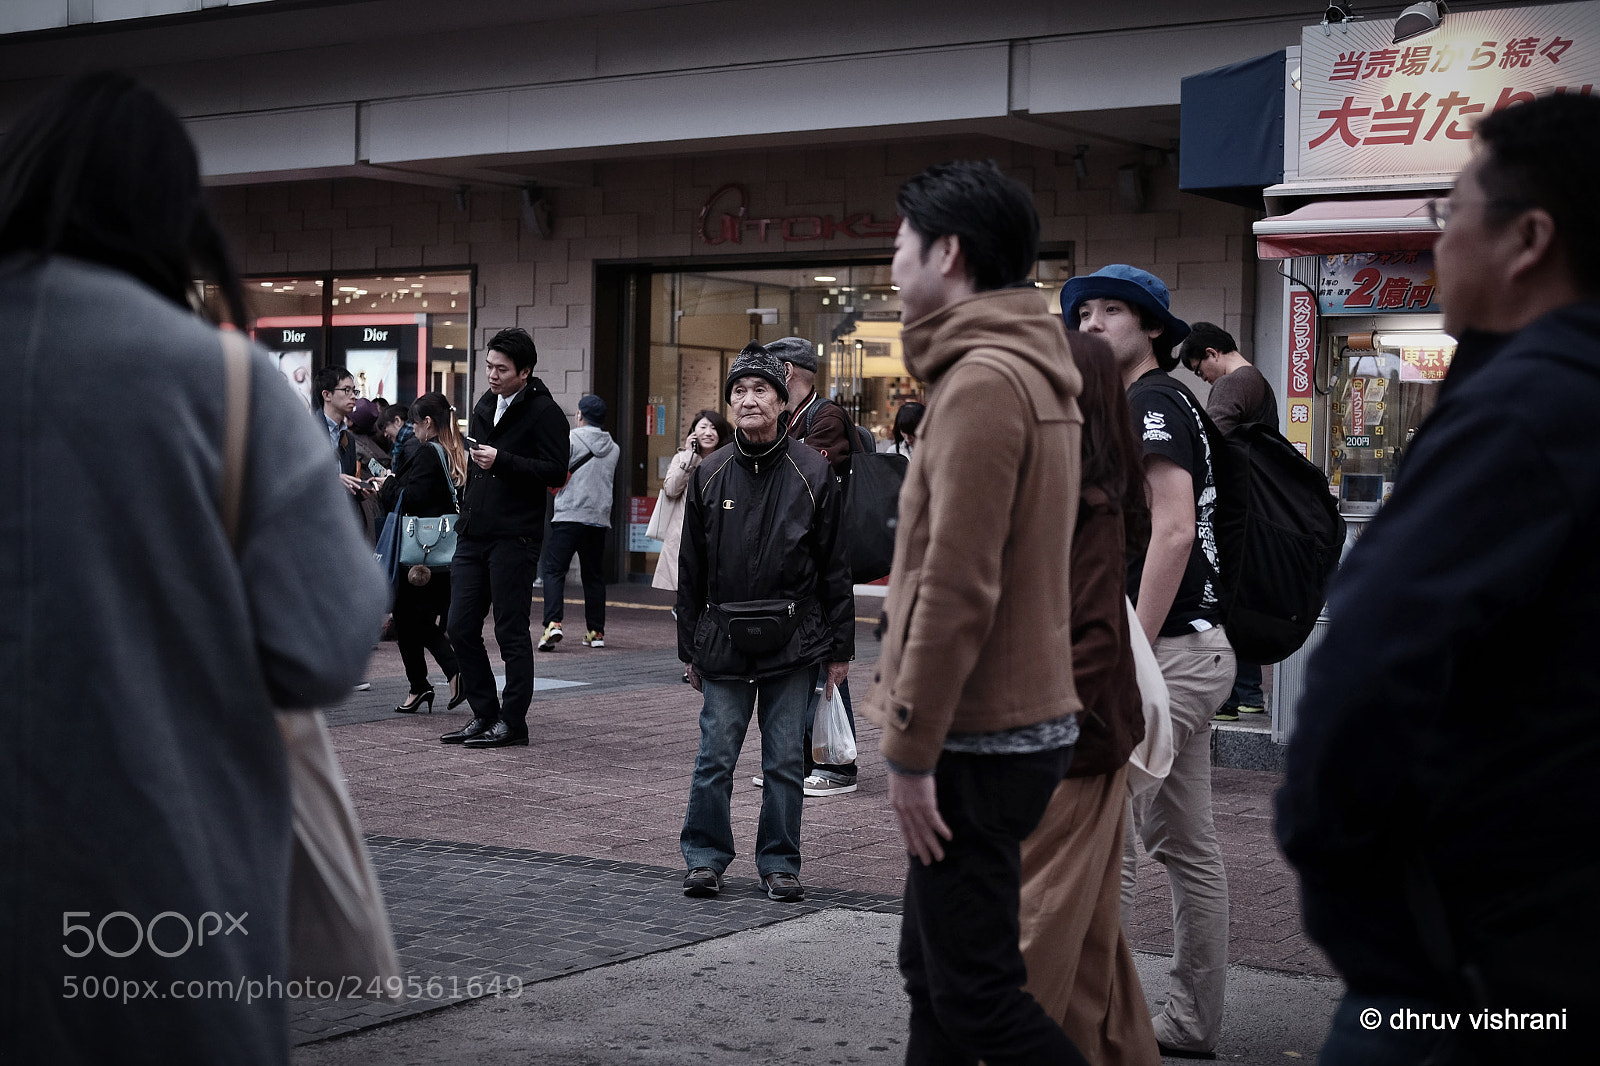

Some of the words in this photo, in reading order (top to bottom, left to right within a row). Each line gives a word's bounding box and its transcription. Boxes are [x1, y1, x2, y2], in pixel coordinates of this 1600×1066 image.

[1328, 36, 1574, 82] 当売場から続々
[1343, 267, 1436, 310] 2億円
[282, 329, 306, 343] Dior
[363, 328, 389, 342] Dior
[1292, 296, 1312, 392] スクラッチくじ
[1353, 391, 1363, 435] スクラッチ
[1376, 402, 1384, 411] 3
[1375, 427, 1383, 435] 4
[1346, 436, 1370, 447] 200円
[1375, 450, 1383, 458] 5
